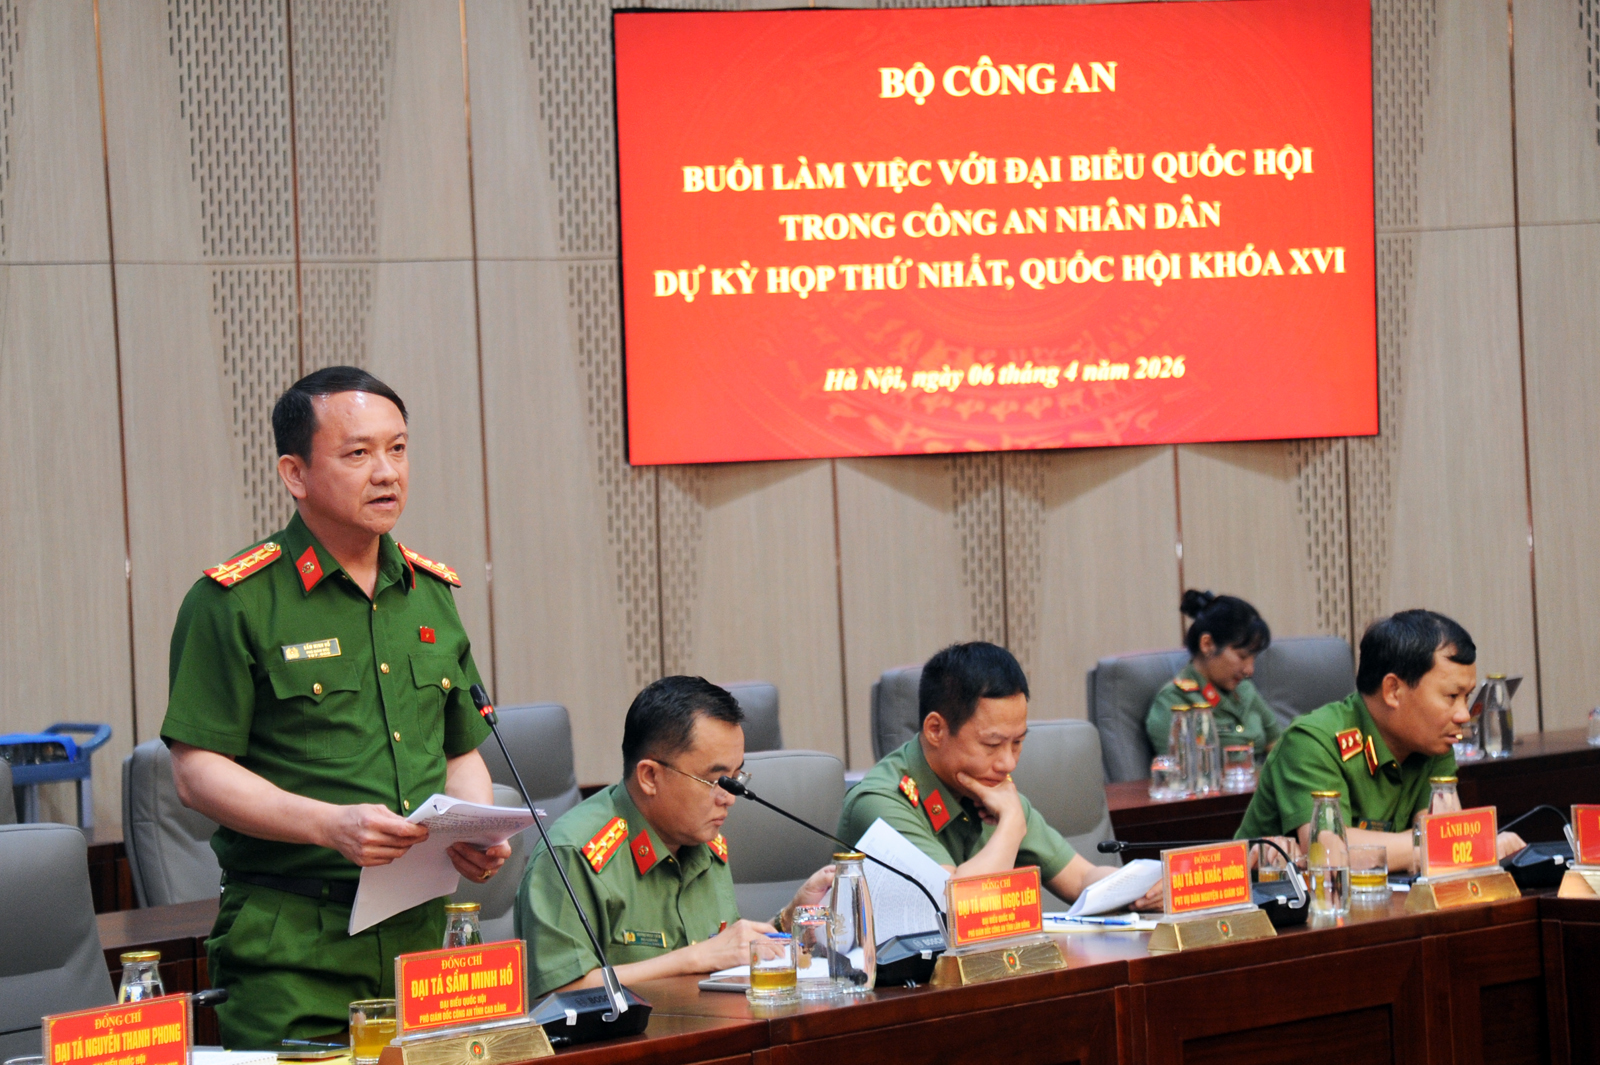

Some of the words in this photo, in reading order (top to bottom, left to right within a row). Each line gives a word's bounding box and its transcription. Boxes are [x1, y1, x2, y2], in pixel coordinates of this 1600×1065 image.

[878, 61, 936, 106] BỘ
[942, 54, 1058, 97] CÔNG
[1062, 61, 1118, 94] AN
[682, 156, 764, 193] BUỔI
[772, 155, 846, 190] LÀM
[852, 156, 932, 194] VIỆC
[937, 150, 998, 186] VỚI
[1003, 156, 1062, 190] ĐẠI
[1069, 146, 1146, 182] BIỂU
[1151, 142, 1246, 184] QUỐC
[1253, 143, 1314, 181] HỘI
[778, 211, 896, 242] TRONG
[902, 201, 998, 238] CÔNG
[1002, 206, 1048, 235] AN
[1054, 196, 1147, 233] NHÂN
[1154, 193, 1222, 229] DÂN
[654, 264, 707, 303] DỰ
[710, 259, 759, 296] KỲ
[766, 264, 836, 300] HỌP
[838, 255, 914, 291] THỨ
[917, 252, 1015, 290] NHẤT,
[1019, 249, 1114, 290] QUỐC
[1121, 249, 1182, 287] HỘI
[1190, 243, 1284, 279] KHÓA
[1288, 246, 1346, 276] XVI
[823, 367, 858, 392] Hà
[862, 366, 907, 394] Nội,
[911, 364, 965, 394] ngày
[967, 362, 995, 386] 06
[998, 361, 1061, 389] tháng
[1064, 359, 1079, 382] 4
[1081, 358, 1130, 382] năm
[1133, 355, 1186, 379] 2026
[1440, 821, 1462, 838] LÃNH
[1463, 821, 1481, 838] ĐẠO
[970, 895, 979, 914] TÁ
[441, 955, 466, 970] ĐỒNG
[467, 953, 482, 966] CHÍ
[411, 979, 428, 1001] ĐẠI
[431, 974, 444, 995] TÁ
[471, 970, 497, 990] MINH
[95, 1013, 122, 1029] ĐỒNG
[124, 1009, 142, 1024] CHÍ
[72, 1036, 83, 1060] TÁ
[85, 1028, 120, 1057] NGUYỄN
[122, 1028, 150, 1051] THANH
[152, 1023, 181, 1045] PHONG
